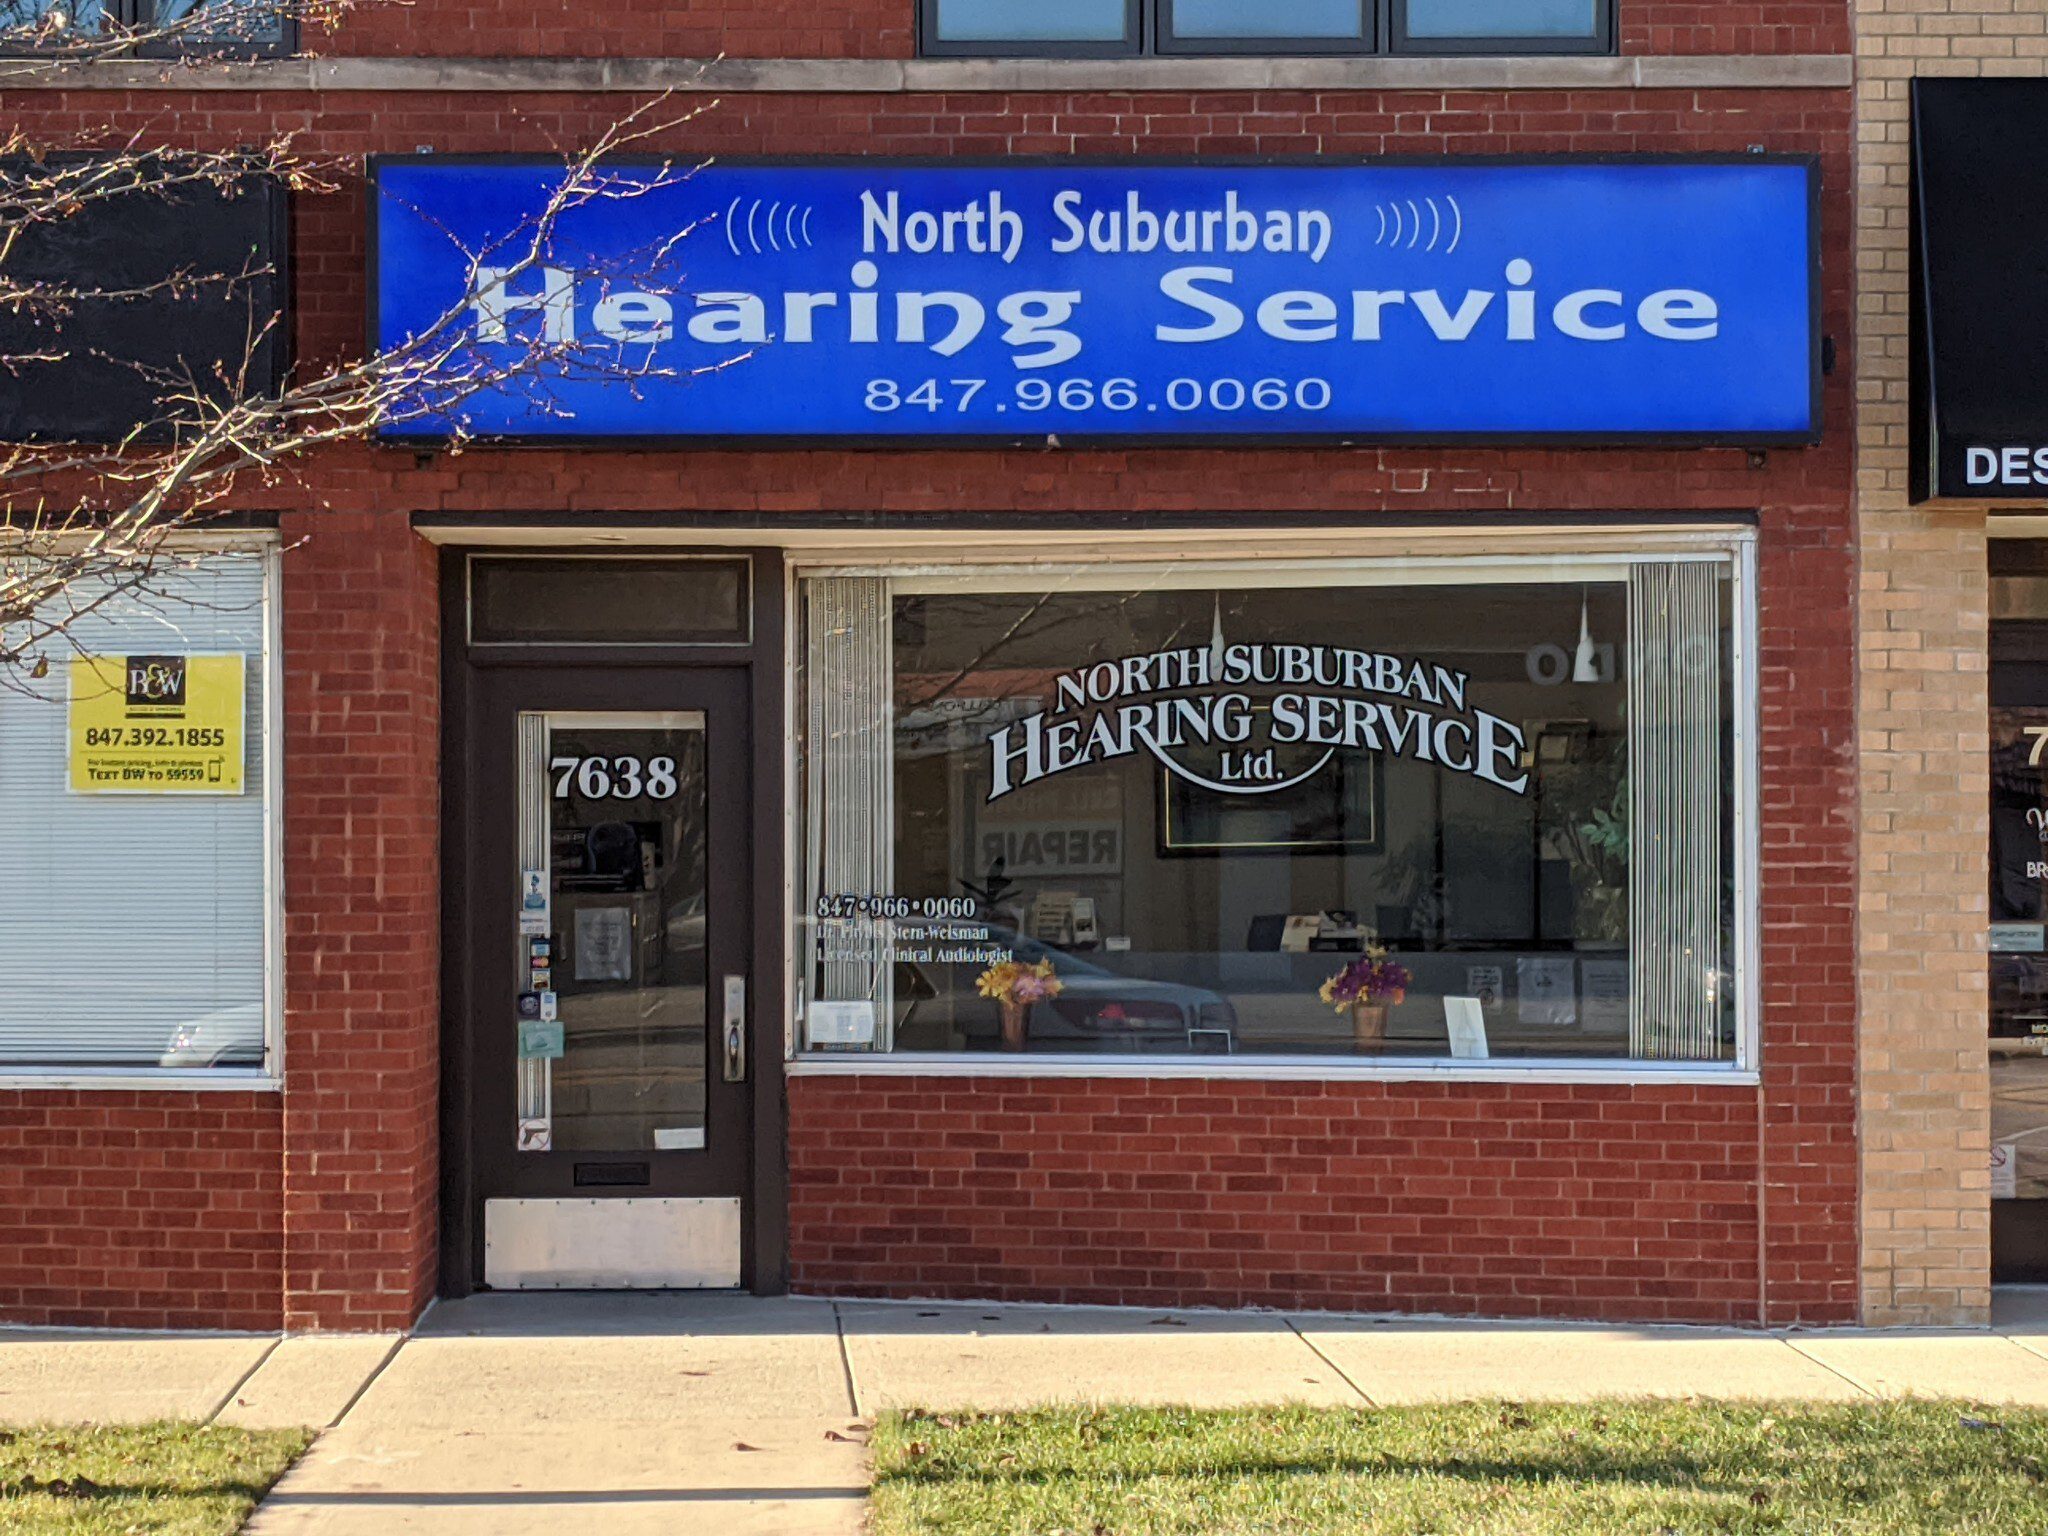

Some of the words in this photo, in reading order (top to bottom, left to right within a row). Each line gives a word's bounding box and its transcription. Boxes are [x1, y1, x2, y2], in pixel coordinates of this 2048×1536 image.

[860, 190, 1023, 264] North
[1053, 190, 1332, 264] Suburban
[470, 260, 1082, 369] Hearing
[1156, 259, 1718, 342] Service
[866, 378, 1331, 412] 847.966.0060
[1055, 647, 1211, 714] NORTH
[1223, 644, 1468, 712] SUBURBAN
[86, 728, 225, 748] 847.392.1855
[987, 693, 1254, 801] HEARING
[1270, 693, 1529, 795] SERVICE
[1219, 748, 1285, 781] Ltd.
[551, 756, 678, 799] 7638
